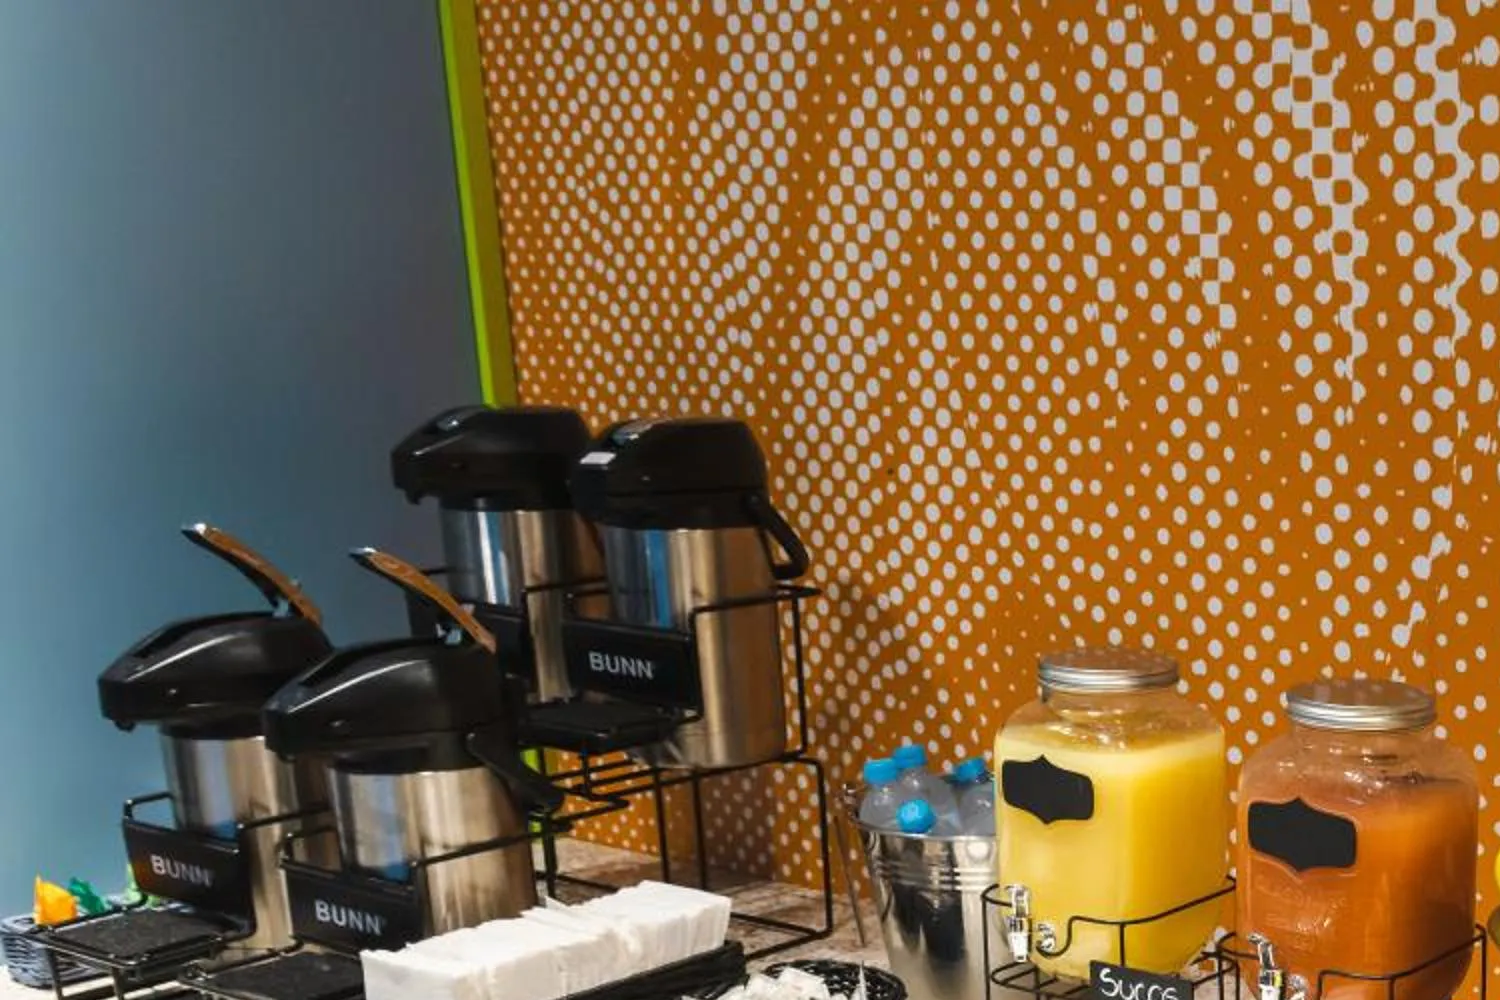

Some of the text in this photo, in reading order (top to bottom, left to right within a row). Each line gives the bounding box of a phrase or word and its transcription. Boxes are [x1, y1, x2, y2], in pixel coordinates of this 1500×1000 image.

[588, 651, 654, 680] BUNN
[150, 854, 212, 888] BUNN
[315, 900, 382, 936] BUNN
